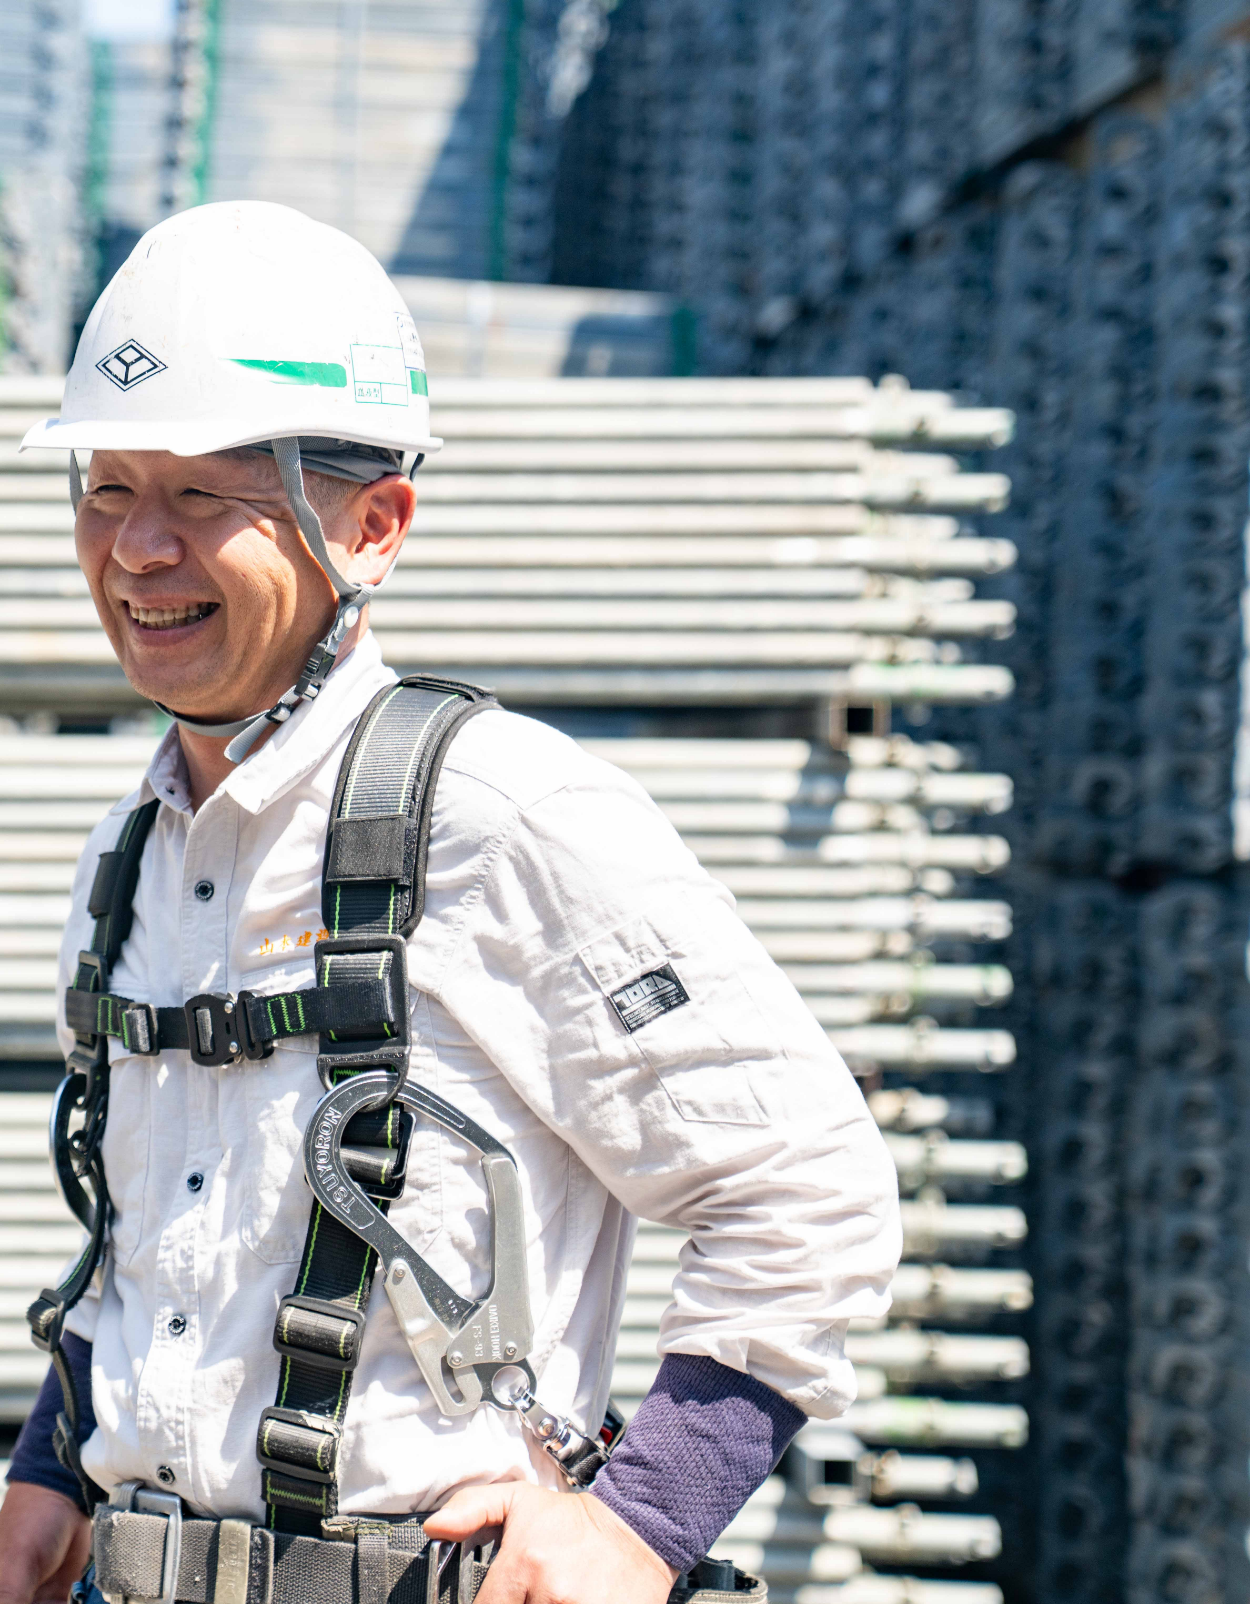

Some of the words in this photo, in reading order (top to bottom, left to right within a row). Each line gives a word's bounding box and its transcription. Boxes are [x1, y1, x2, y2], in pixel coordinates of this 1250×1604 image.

[315, 1106, 356, 1214] TSUYORON
[472, 1325, 484, 1357] FS-93
[490, 1335, 502, 1360] HOOK
